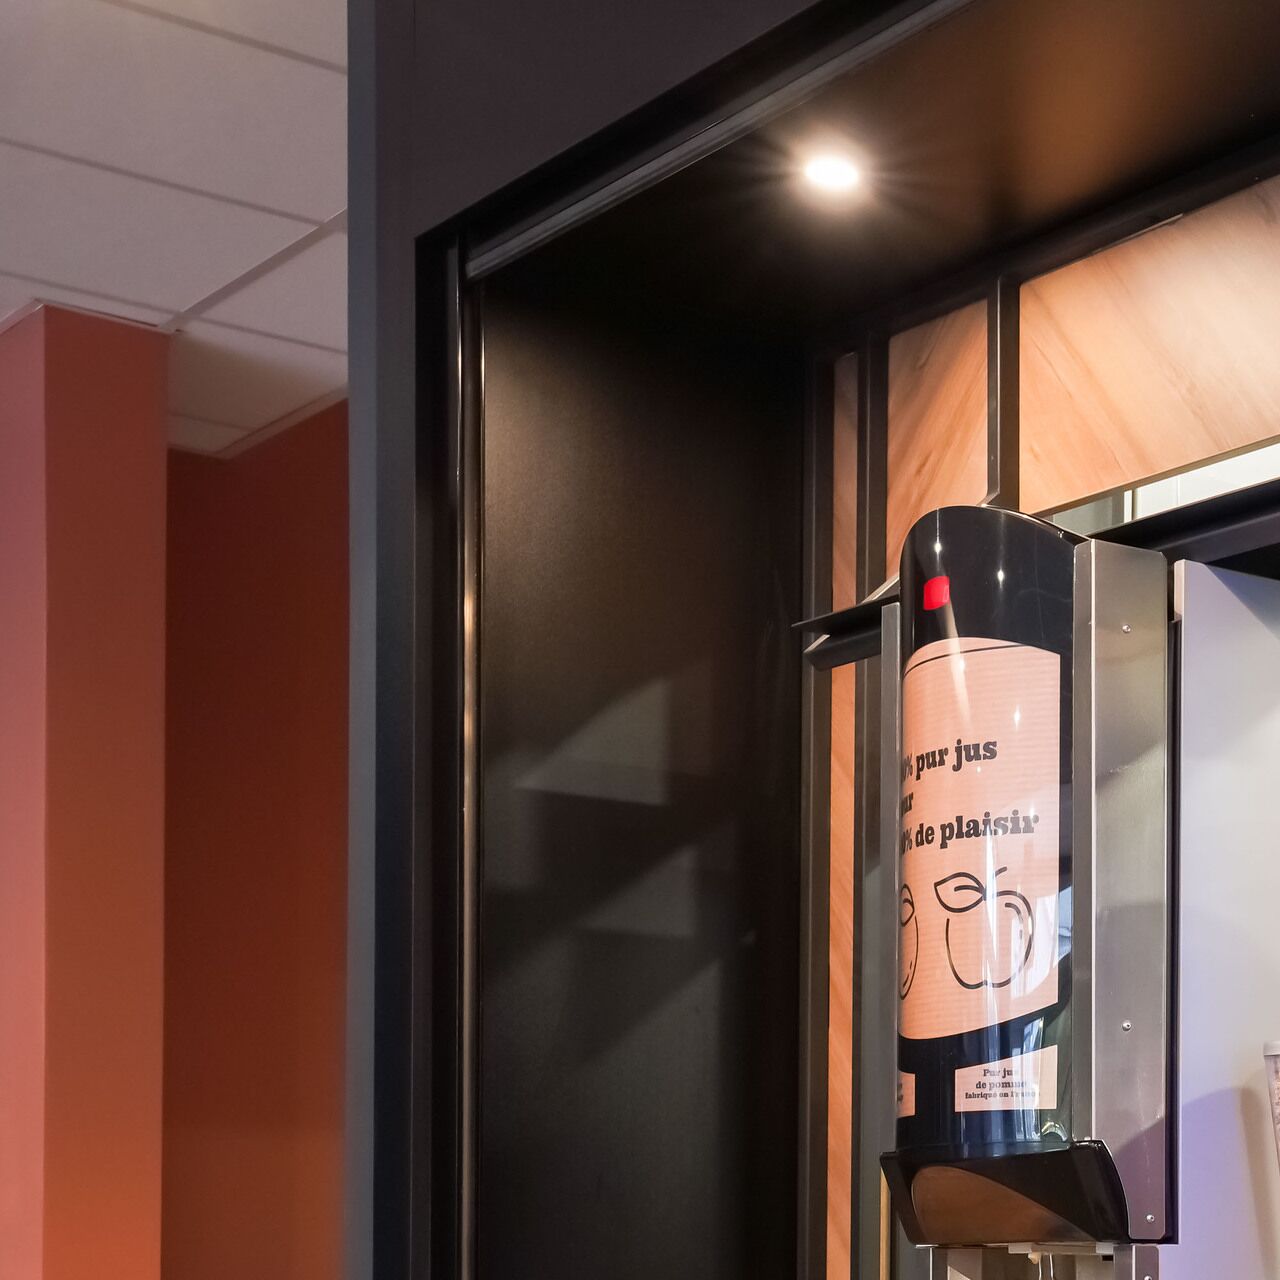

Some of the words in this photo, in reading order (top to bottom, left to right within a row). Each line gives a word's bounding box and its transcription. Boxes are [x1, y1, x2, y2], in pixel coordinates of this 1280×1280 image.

[916, 747, 949, 781] pur
[952, 739, 998, 772] jus
[915, 823, 935, 847] de
[940, 809, 1040, 849] plaisir
[976, 1081, 987, 1089] de
